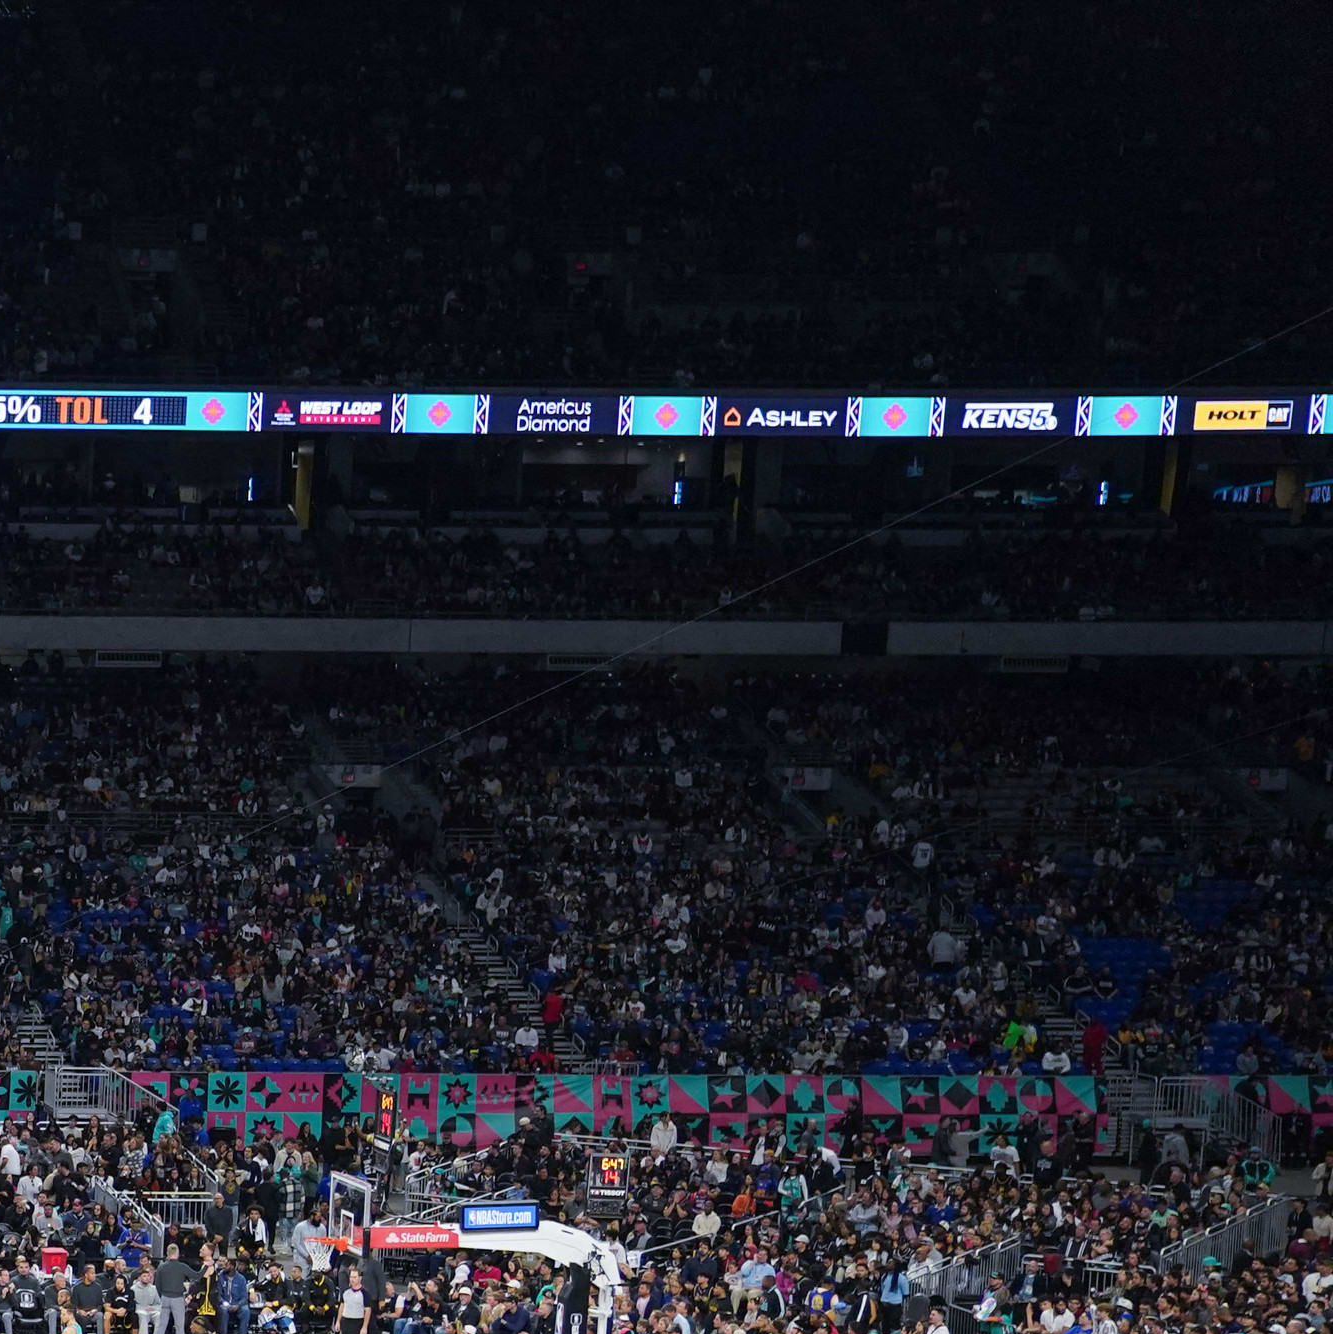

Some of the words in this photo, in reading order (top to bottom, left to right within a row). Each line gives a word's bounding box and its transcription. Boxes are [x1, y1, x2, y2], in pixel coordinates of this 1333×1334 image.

[55, 396, 109, 425] TOL
[133, 397, 153, 425] 4
[299, 400, 342, 415] WEST
[342, 401, 383, 416] LOOP
[518, 398, 592, 416] Americus
[1268, 407, 1291, 423] CAT
[746, 407, 838, 428] ASHLEY
[1207, 409, 1262, 422] HOLT
[516, 415, 591, 433] Diamond
[601, 1157, 626, 1171] 6:47
[605, 1170, 621, 1185] 14
[476, 1209, 532, 1225] NBAStore.com
